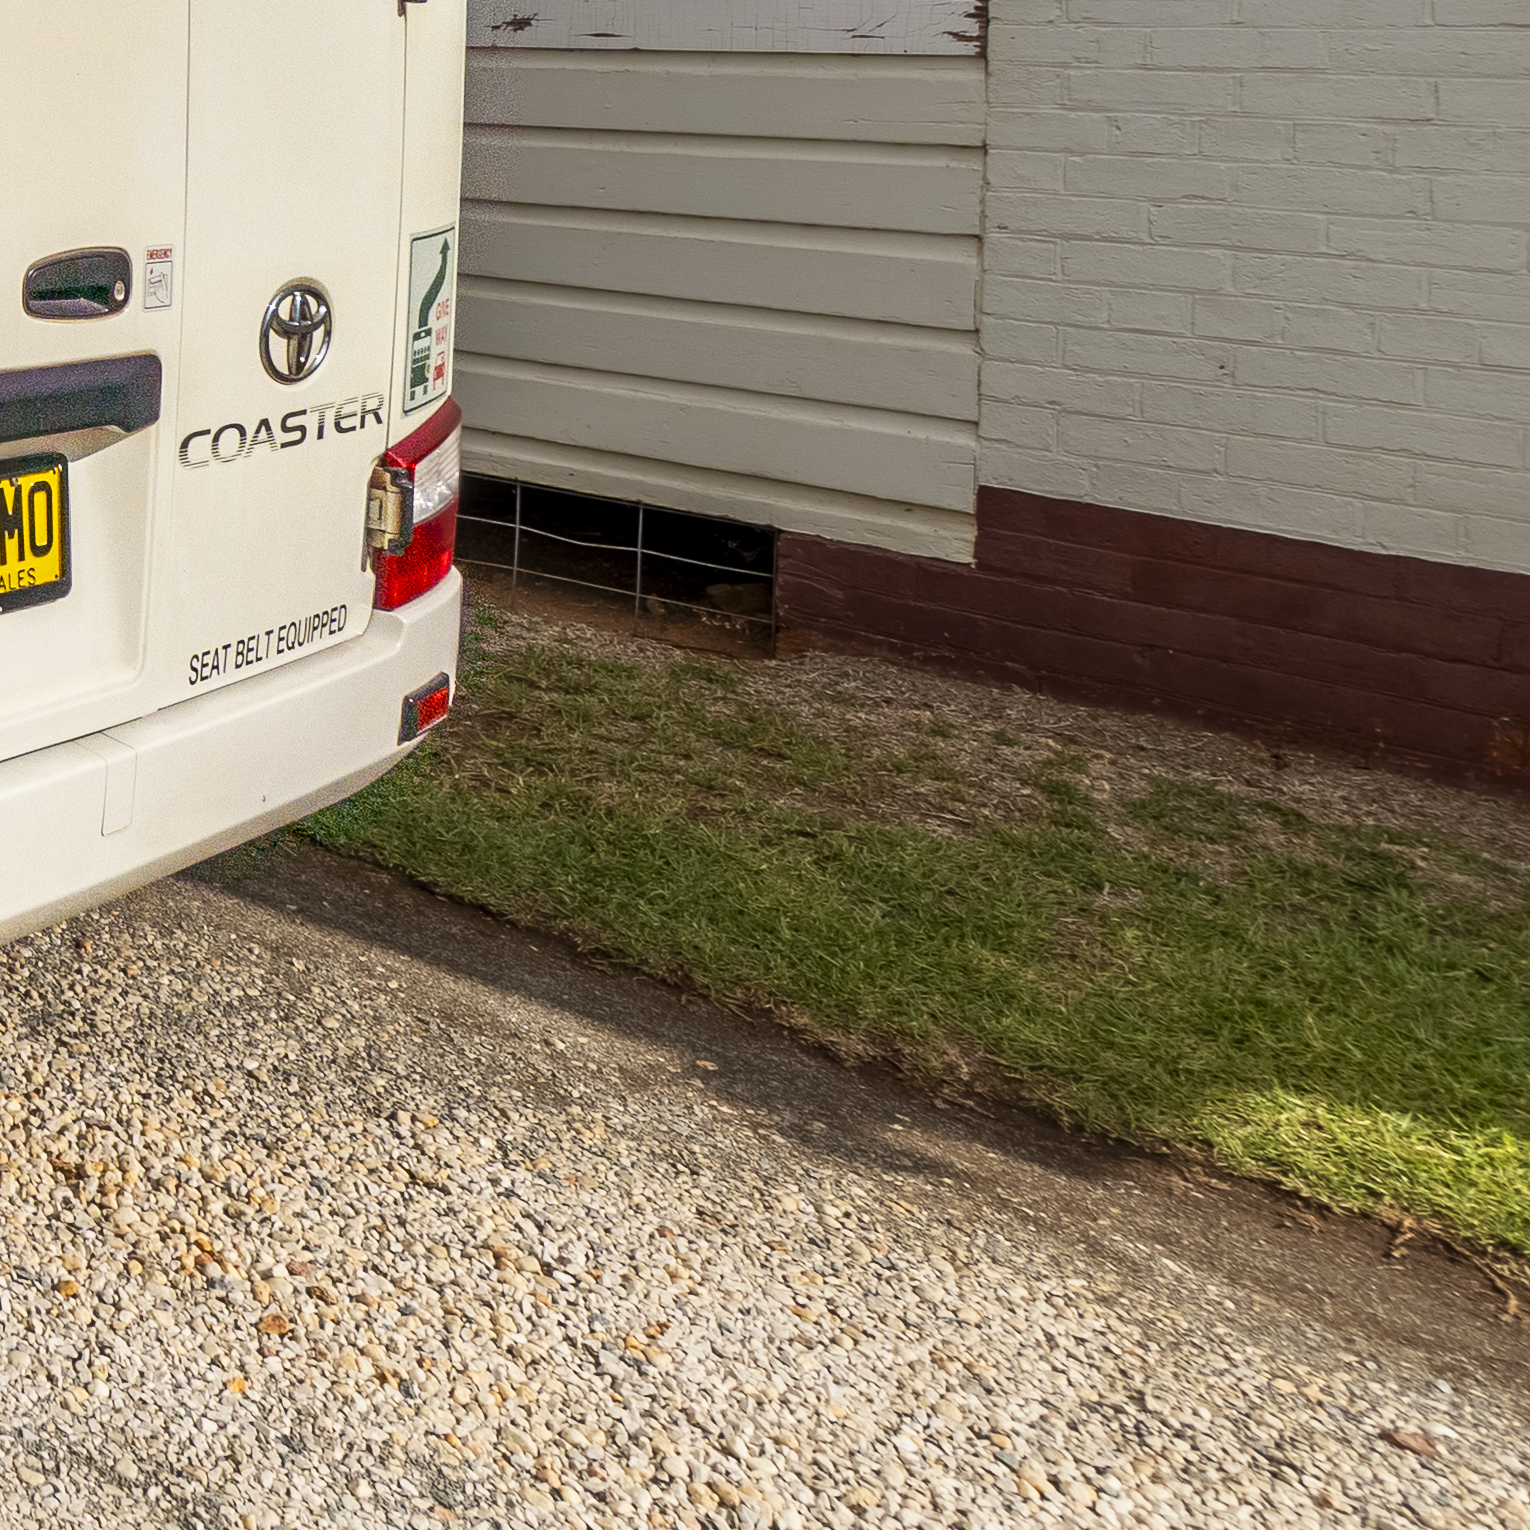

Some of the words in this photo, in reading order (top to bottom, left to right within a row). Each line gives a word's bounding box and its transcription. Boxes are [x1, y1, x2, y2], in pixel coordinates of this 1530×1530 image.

[178, 391, 385, 470] COASTER
[188, 643, 229, 686] SEAT
[234, 629, 275, 669] BELT
[276, 603, 348, 657] EQUIPPED
